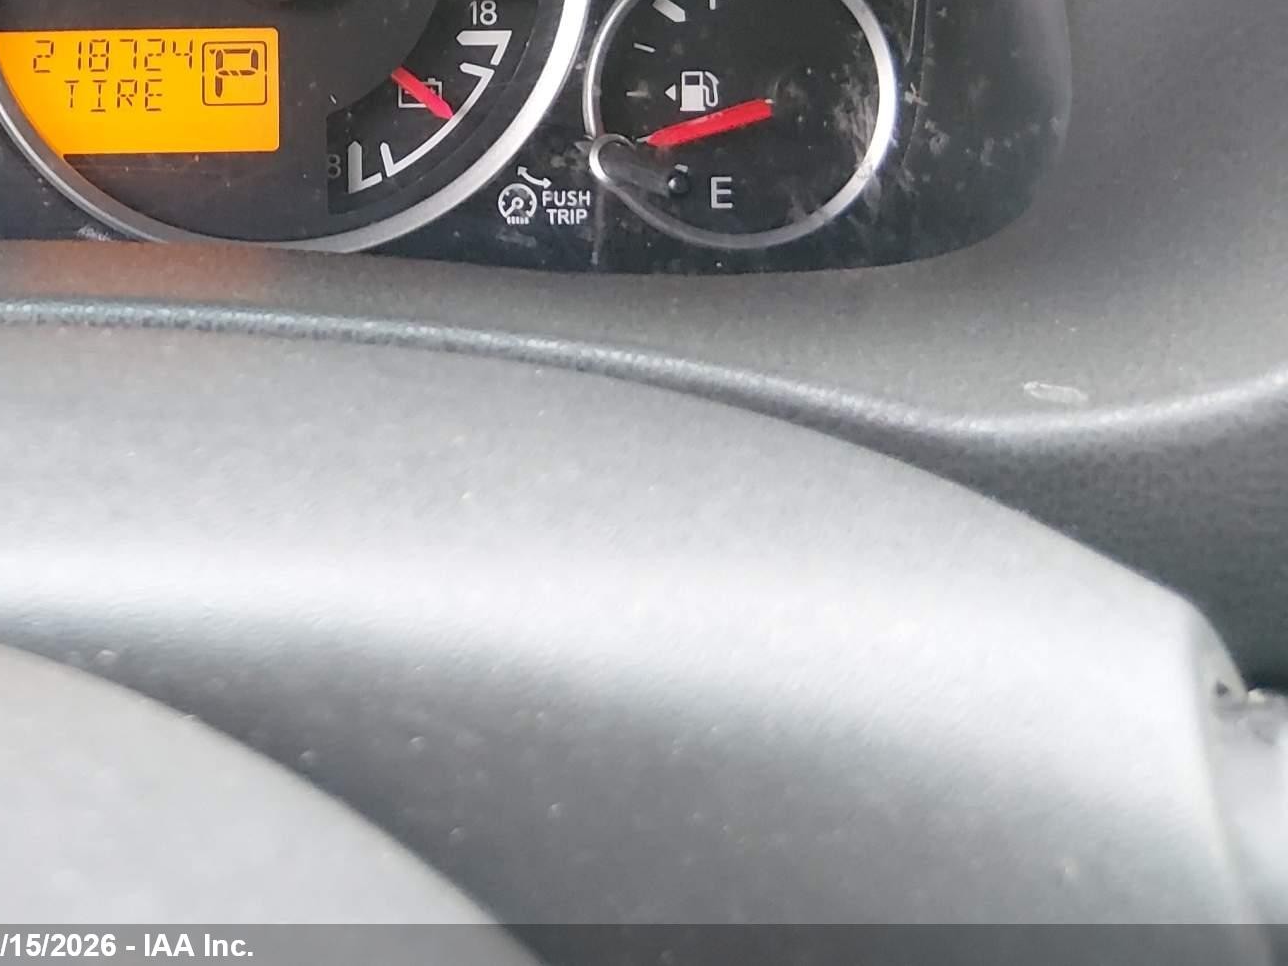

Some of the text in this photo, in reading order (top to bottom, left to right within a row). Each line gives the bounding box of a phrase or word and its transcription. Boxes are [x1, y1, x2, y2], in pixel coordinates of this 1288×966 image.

[471, 1, 497, 25] 18
[33, 39, 193, 73] 218724
[209, 48, 258, 98] P
[64, 79, 163, 112] TIRE
[542, 190, 591, 207] PUSH
[711, 177, 733, 208] E
[546, 208, 588, 225] TRIP
